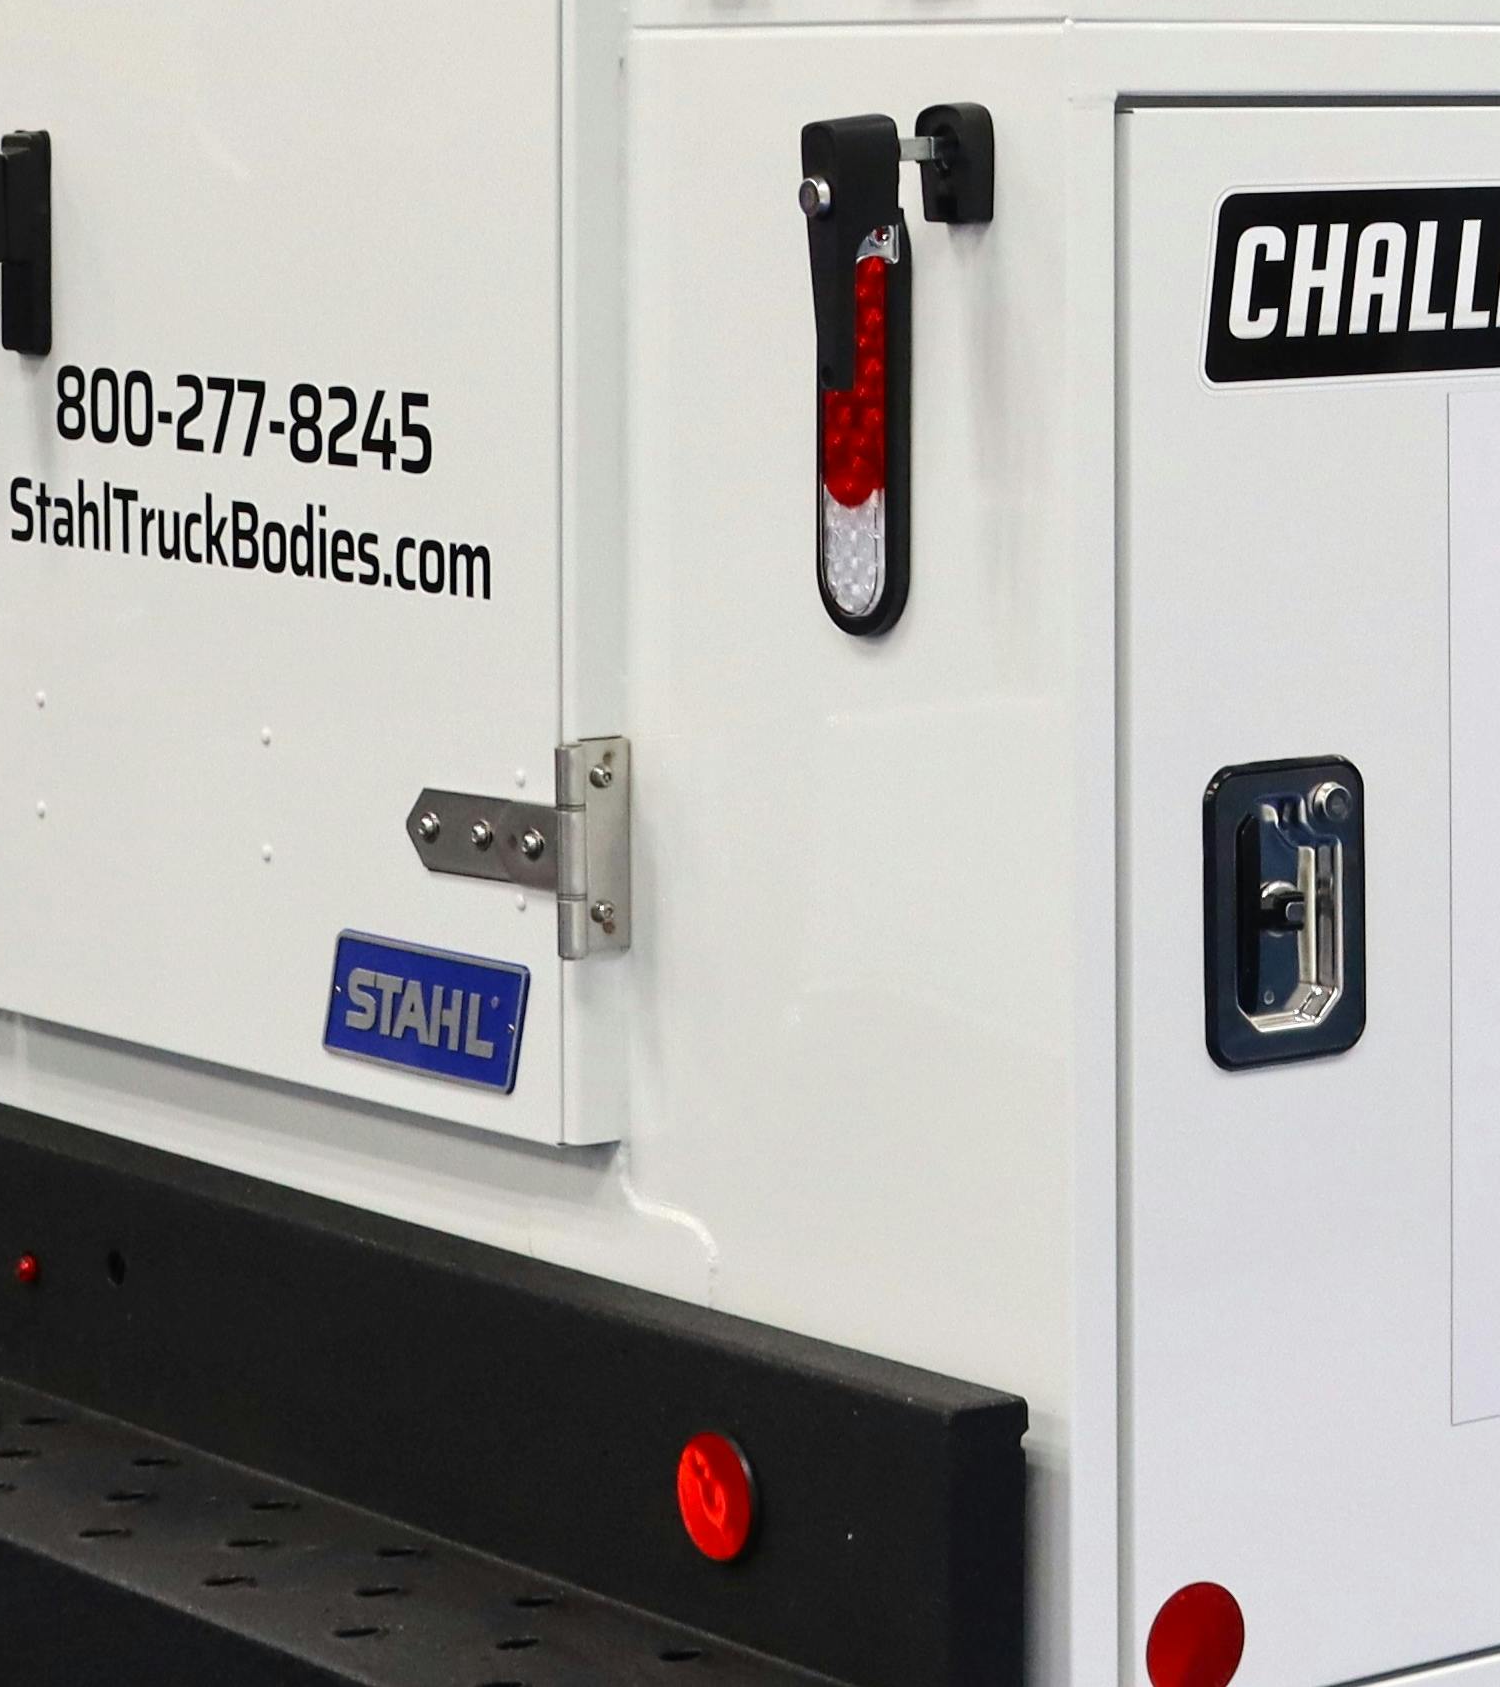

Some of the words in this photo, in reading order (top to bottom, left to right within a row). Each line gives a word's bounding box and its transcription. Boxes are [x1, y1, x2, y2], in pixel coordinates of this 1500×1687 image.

[57, 364, 432, 475] 800-277-8245
[10, 475, 492, 601] StahlTruckBodies.com
[345, 967, 494, 1060] STAHL
